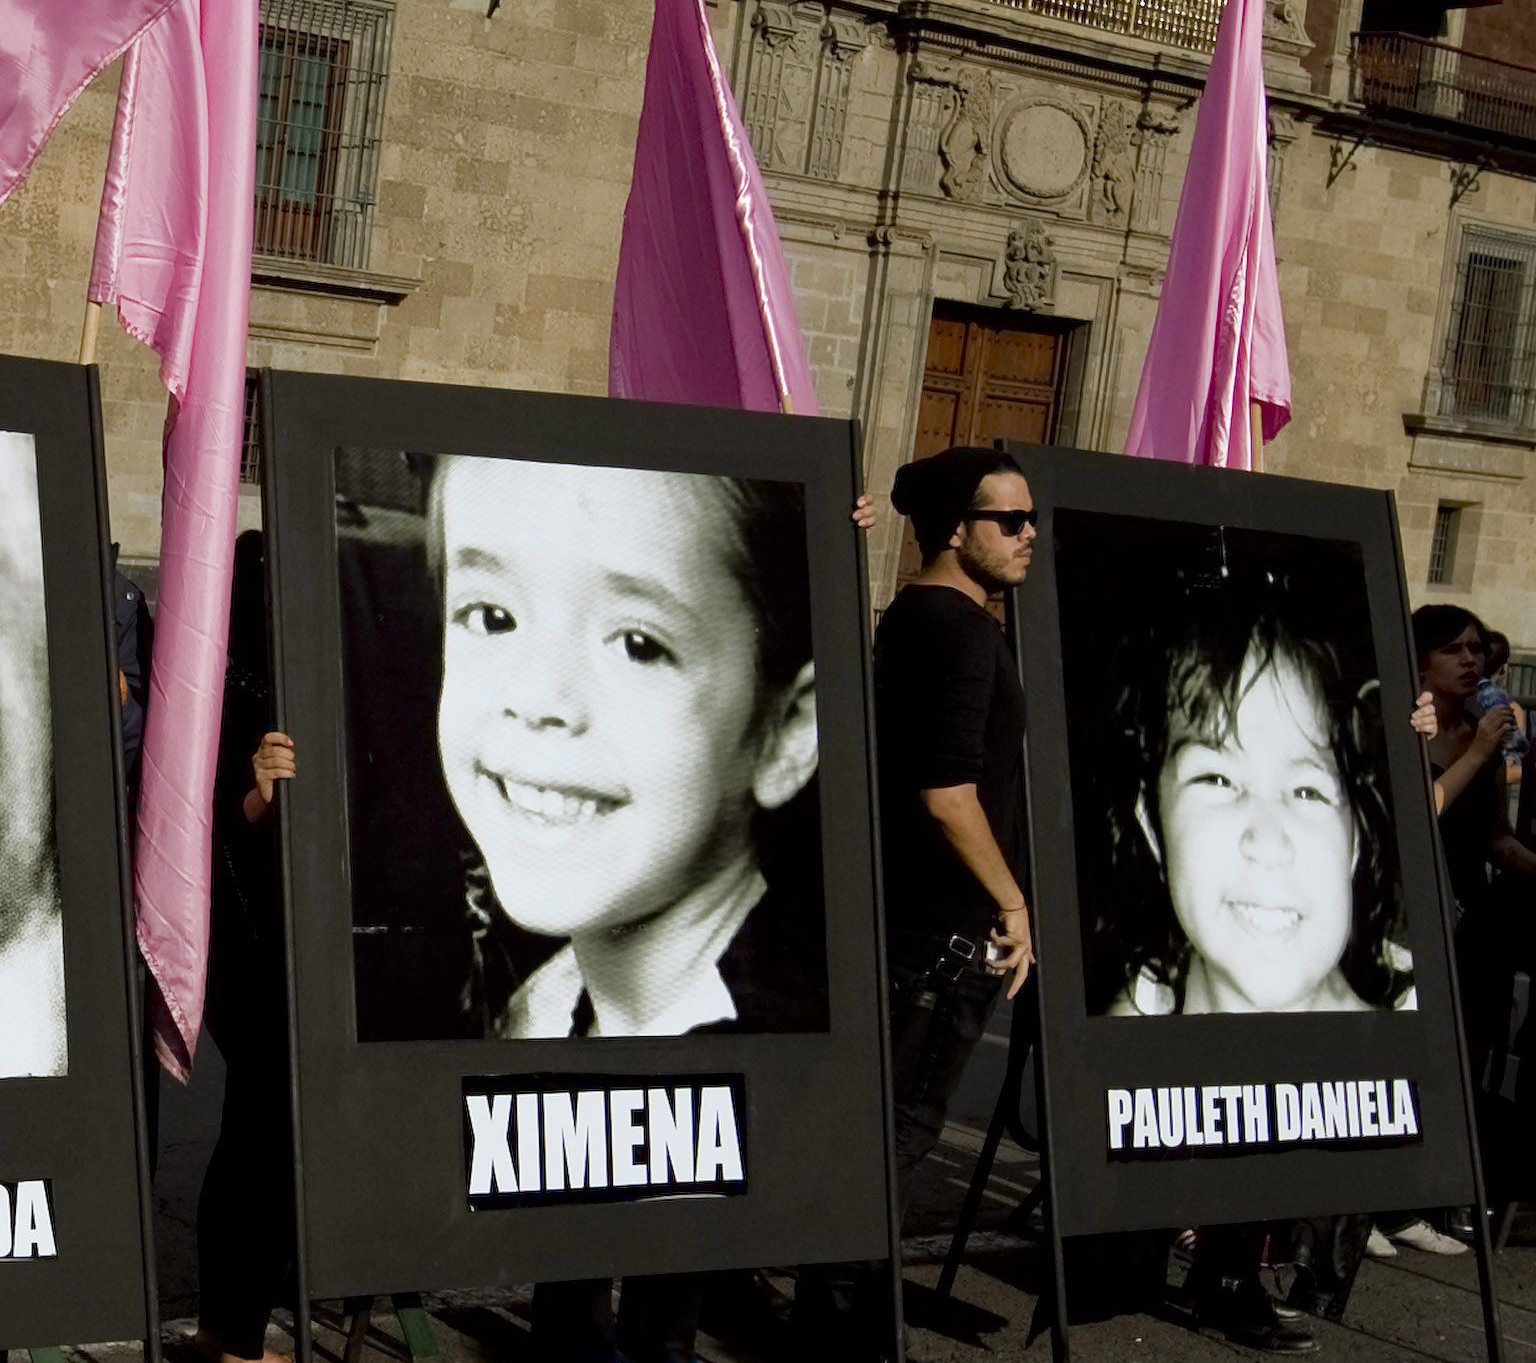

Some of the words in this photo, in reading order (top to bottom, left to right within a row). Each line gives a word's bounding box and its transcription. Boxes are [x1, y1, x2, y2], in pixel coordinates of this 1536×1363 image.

[465, 1086, 744, 1196] XIMENA
[1107, 1084, 1270, 1149] PAULETH
[1274, 1078, 1419, 1142] DANIELA
